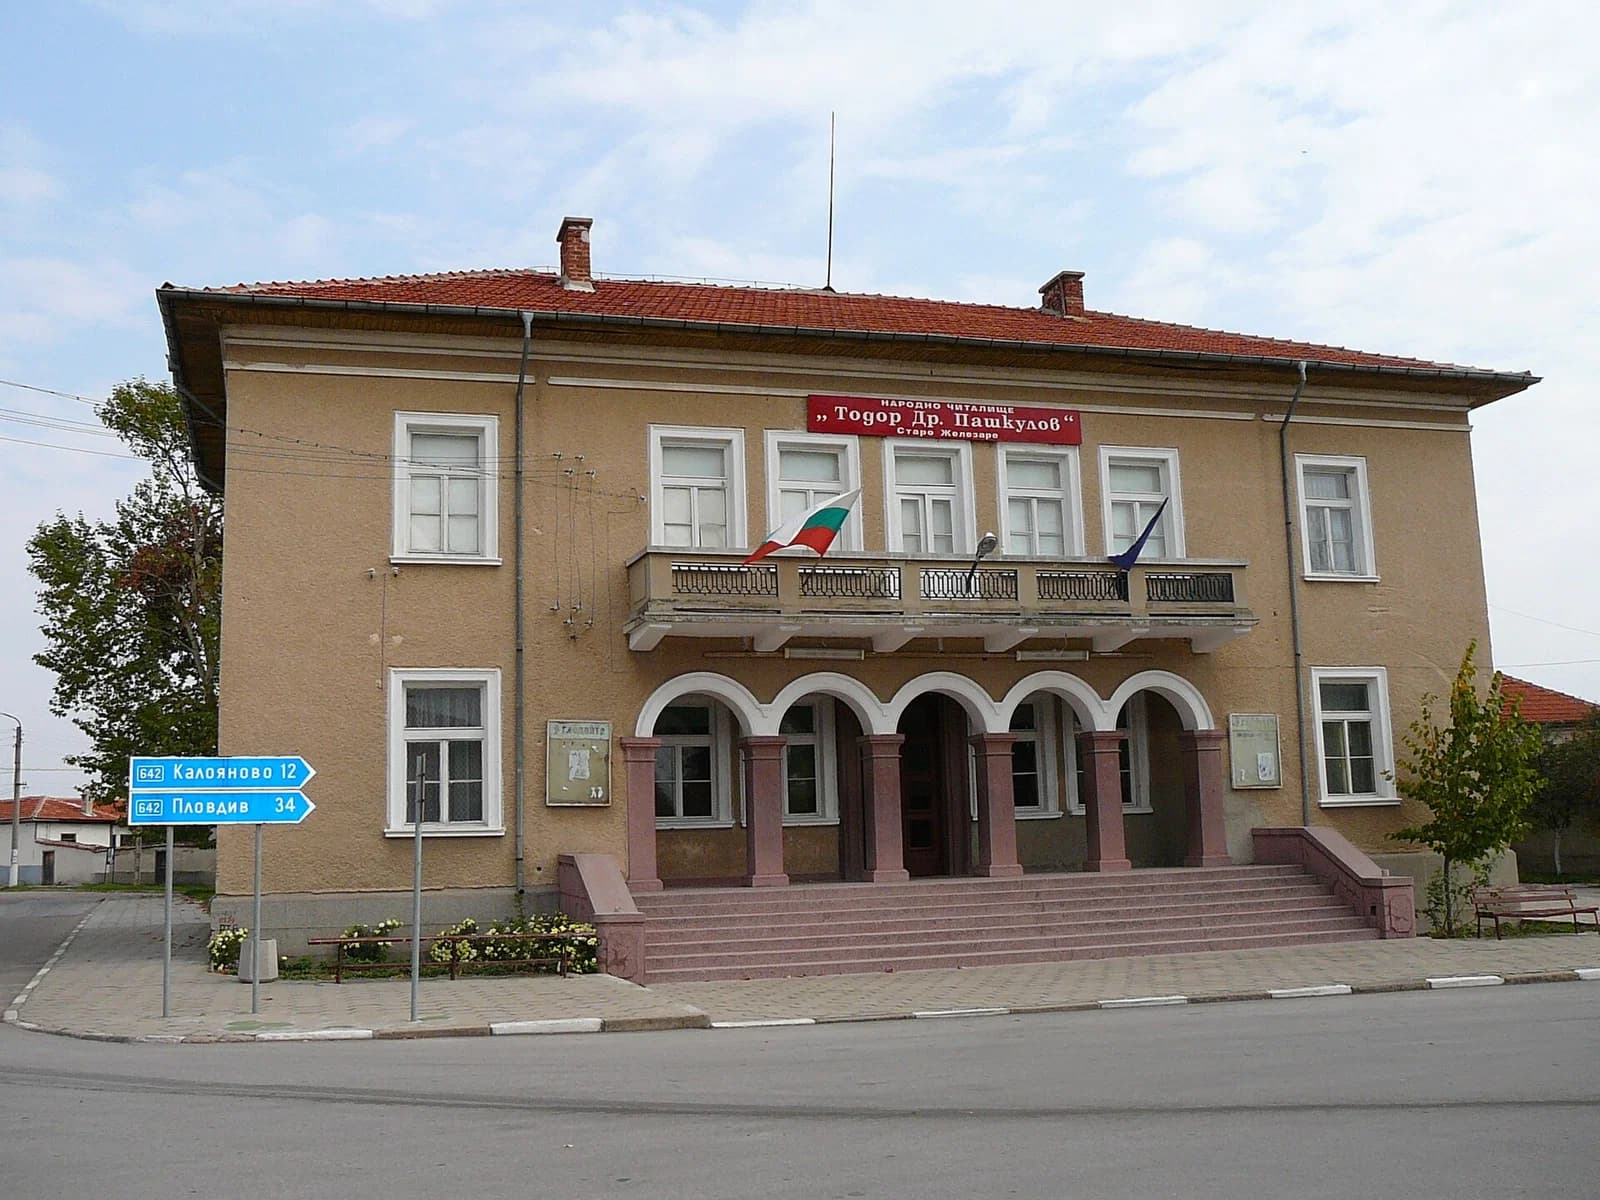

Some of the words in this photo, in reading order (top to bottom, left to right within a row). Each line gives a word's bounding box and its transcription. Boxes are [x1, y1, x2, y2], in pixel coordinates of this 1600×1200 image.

[881, 399, 941, 410] НАРОДНО
[946, 403, 1015, 414] ЧИТАЛИЩЕ
[911, 410, 943, 427] Др.
[896, 426, 935, 437] Старо
[139, 767, 162, 779] 642
[173, 763, 273, 780] Калояново
[280, 763, 297, 779] 12
[138, 802, 160, 814] 642
[172, 797, 249, 815] Пловдив
[275, 797, 295, 813] 34
